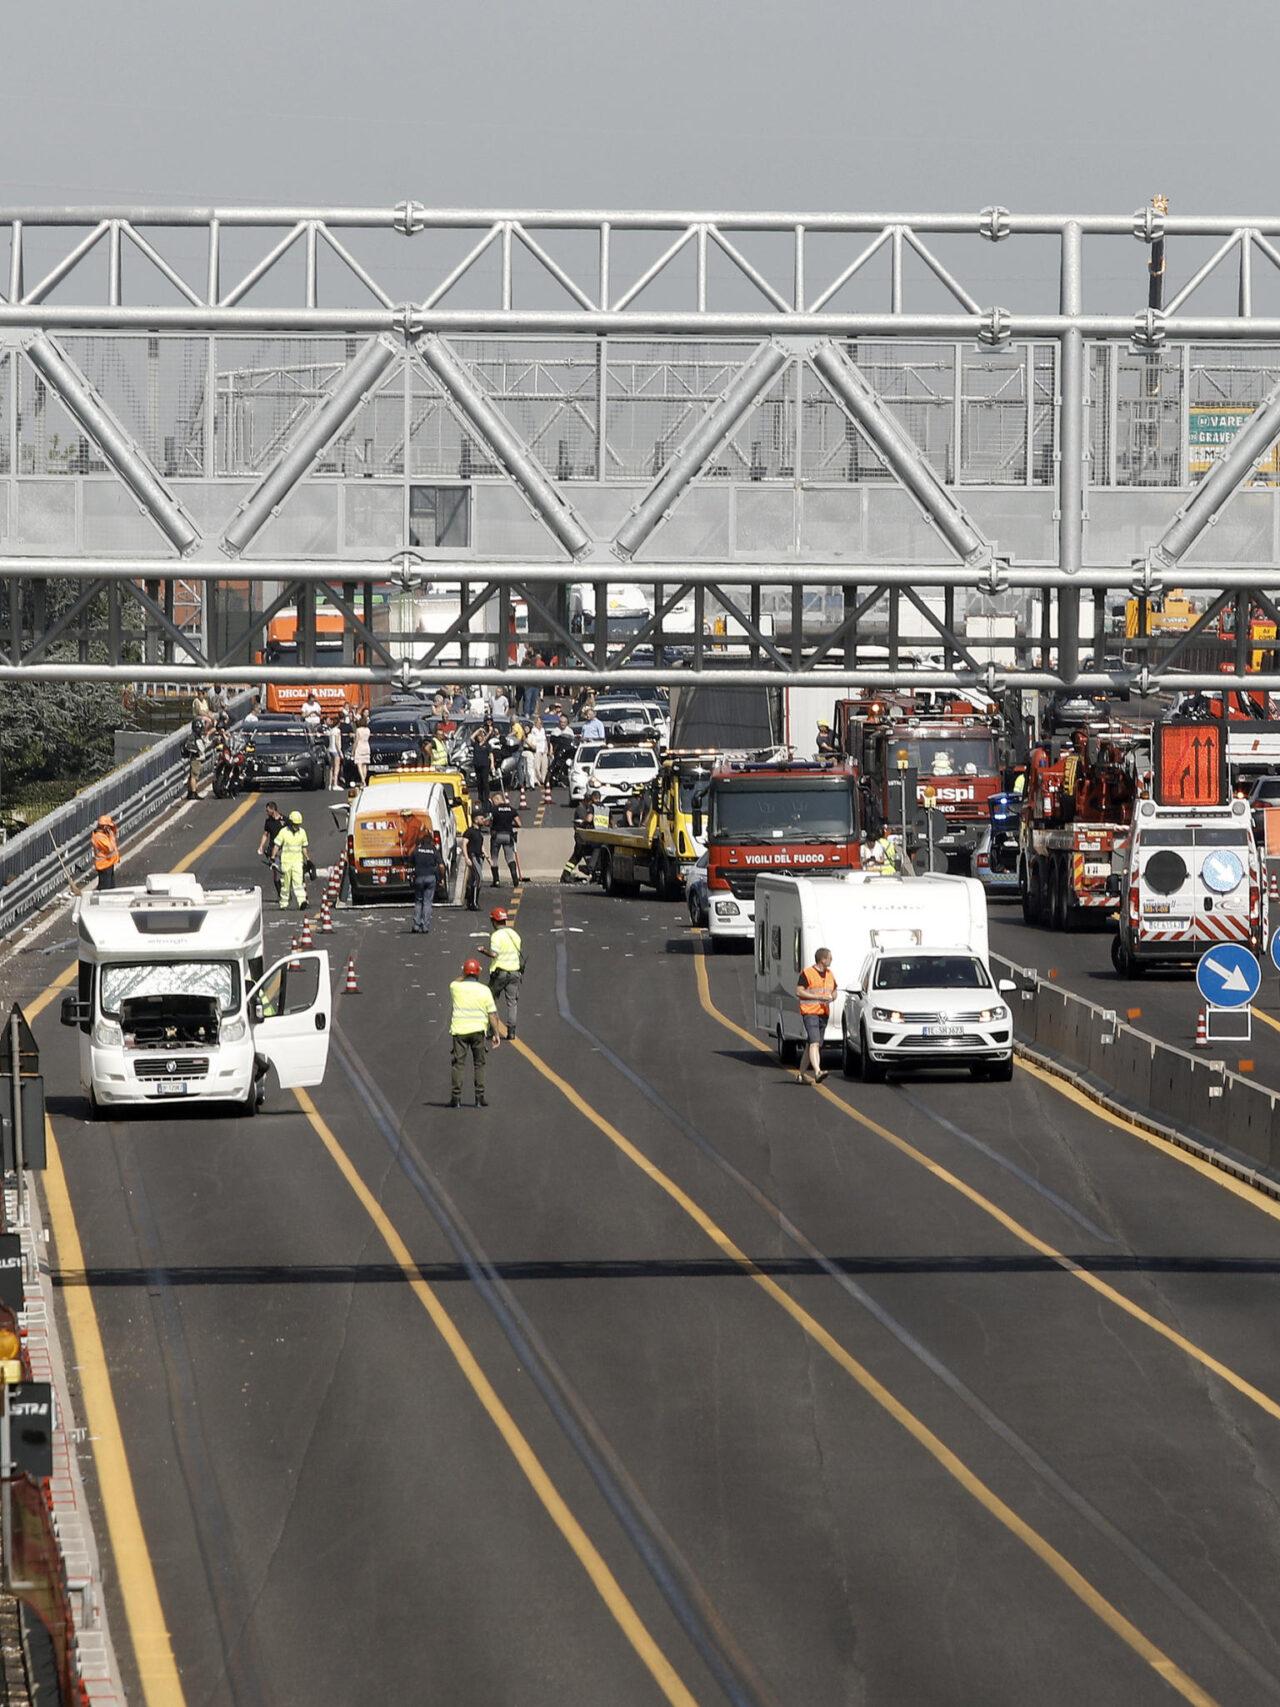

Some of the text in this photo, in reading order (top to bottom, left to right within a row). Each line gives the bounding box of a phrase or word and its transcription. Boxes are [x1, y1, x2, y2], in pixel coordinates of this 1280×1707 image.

[745, 854, 825, 864] VIGILI DEL FUOCO
